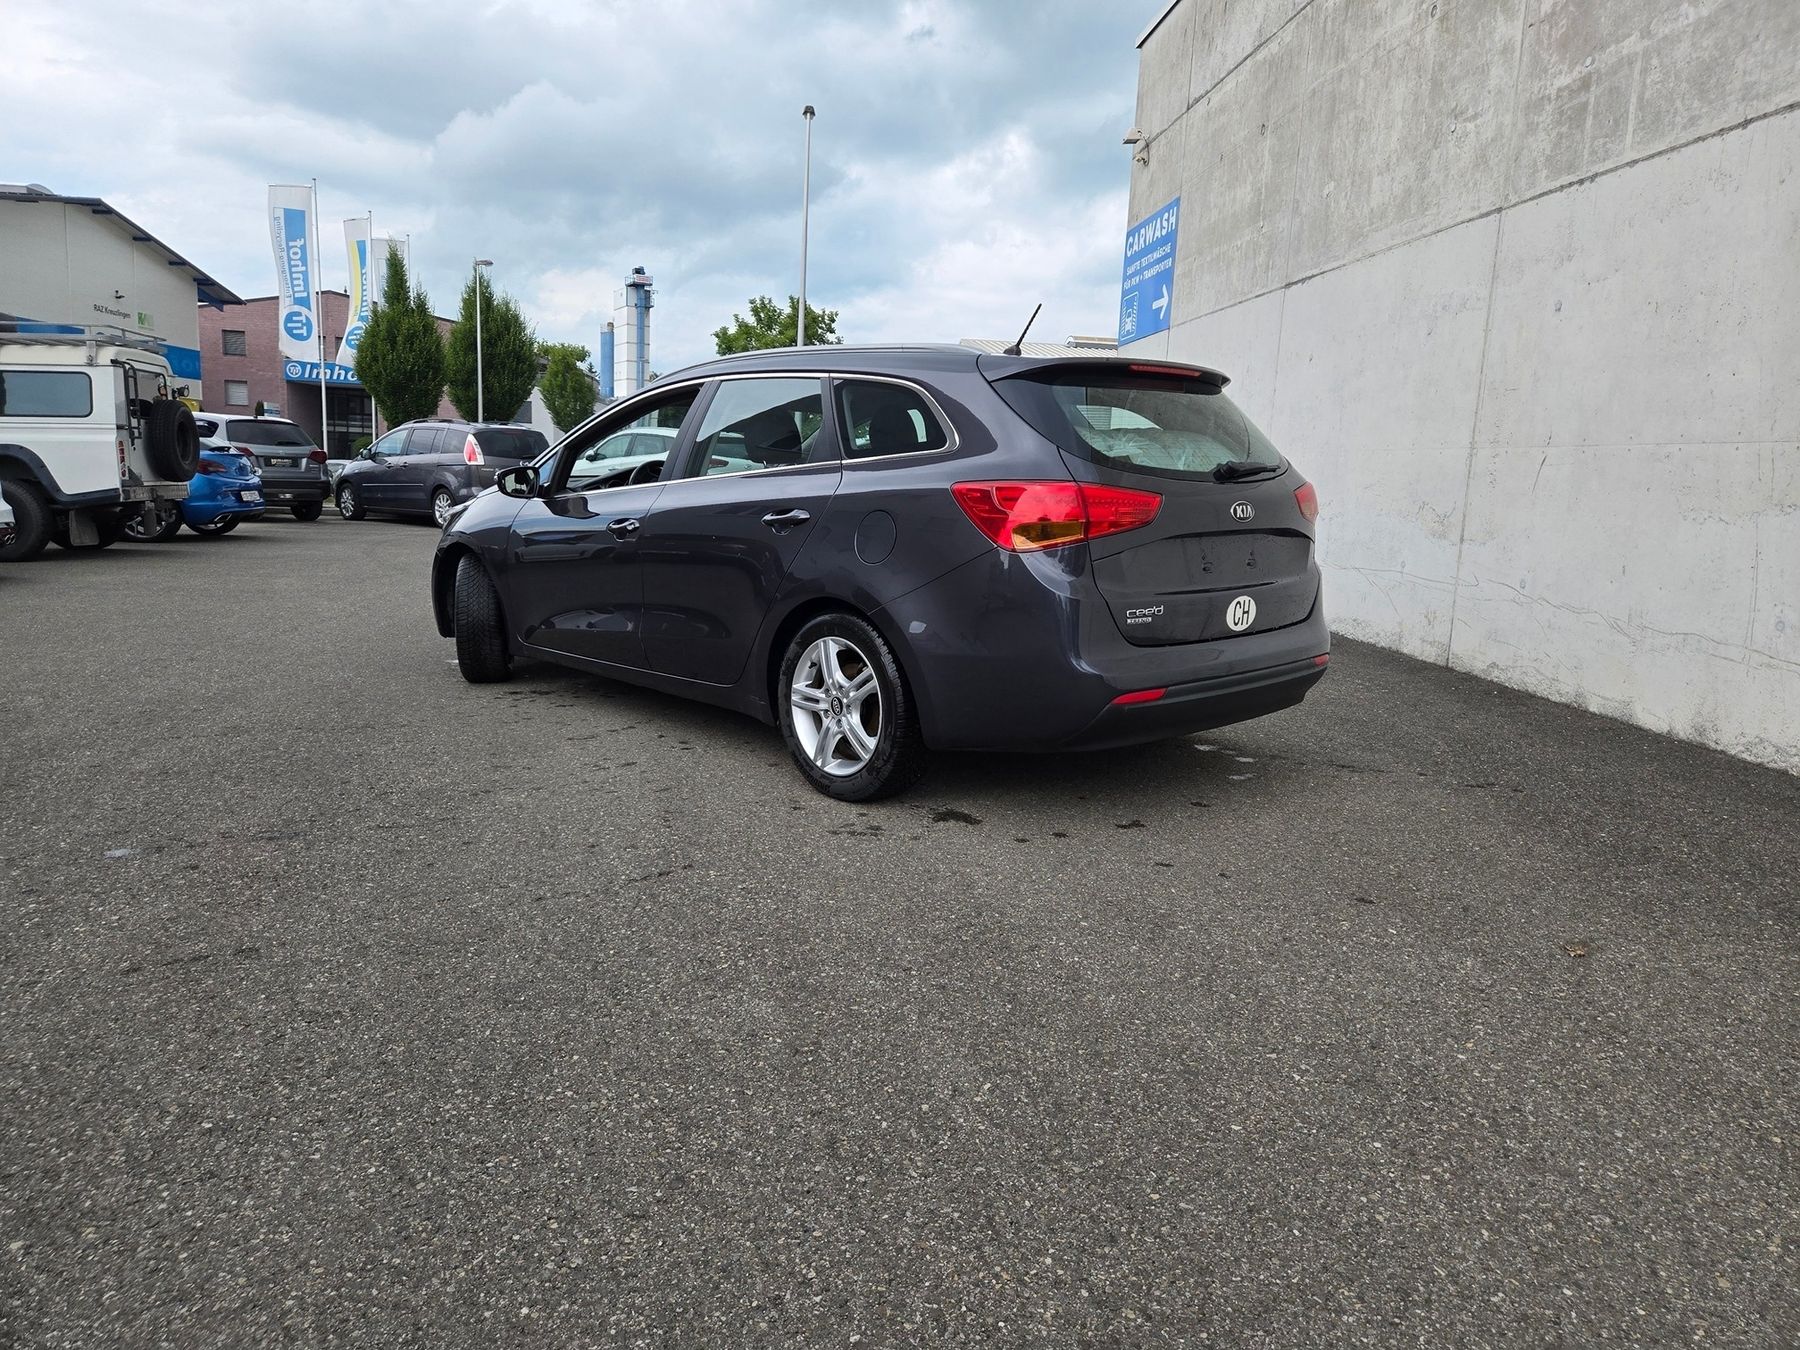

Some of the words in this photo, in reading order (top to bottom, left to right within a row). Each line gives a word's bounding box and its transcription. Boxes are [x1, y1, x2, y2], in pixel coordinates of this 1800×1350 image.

[1126, 207, 1177, 257] CARWASH
[1123, 278, 1131, 292] FÜR
[1131, 274, 1140, 286] PKW
[1143, 257, 1172, 280] TRANSPORTER
[1126, 260, 1141, 276] SANFTE
[304, 364, 358, 381] Imho
[1235, 504, 1253, 518] KIA
[1126, 604, 1164, 618] cee'd
[1233, 599, 1251, 627] CH
